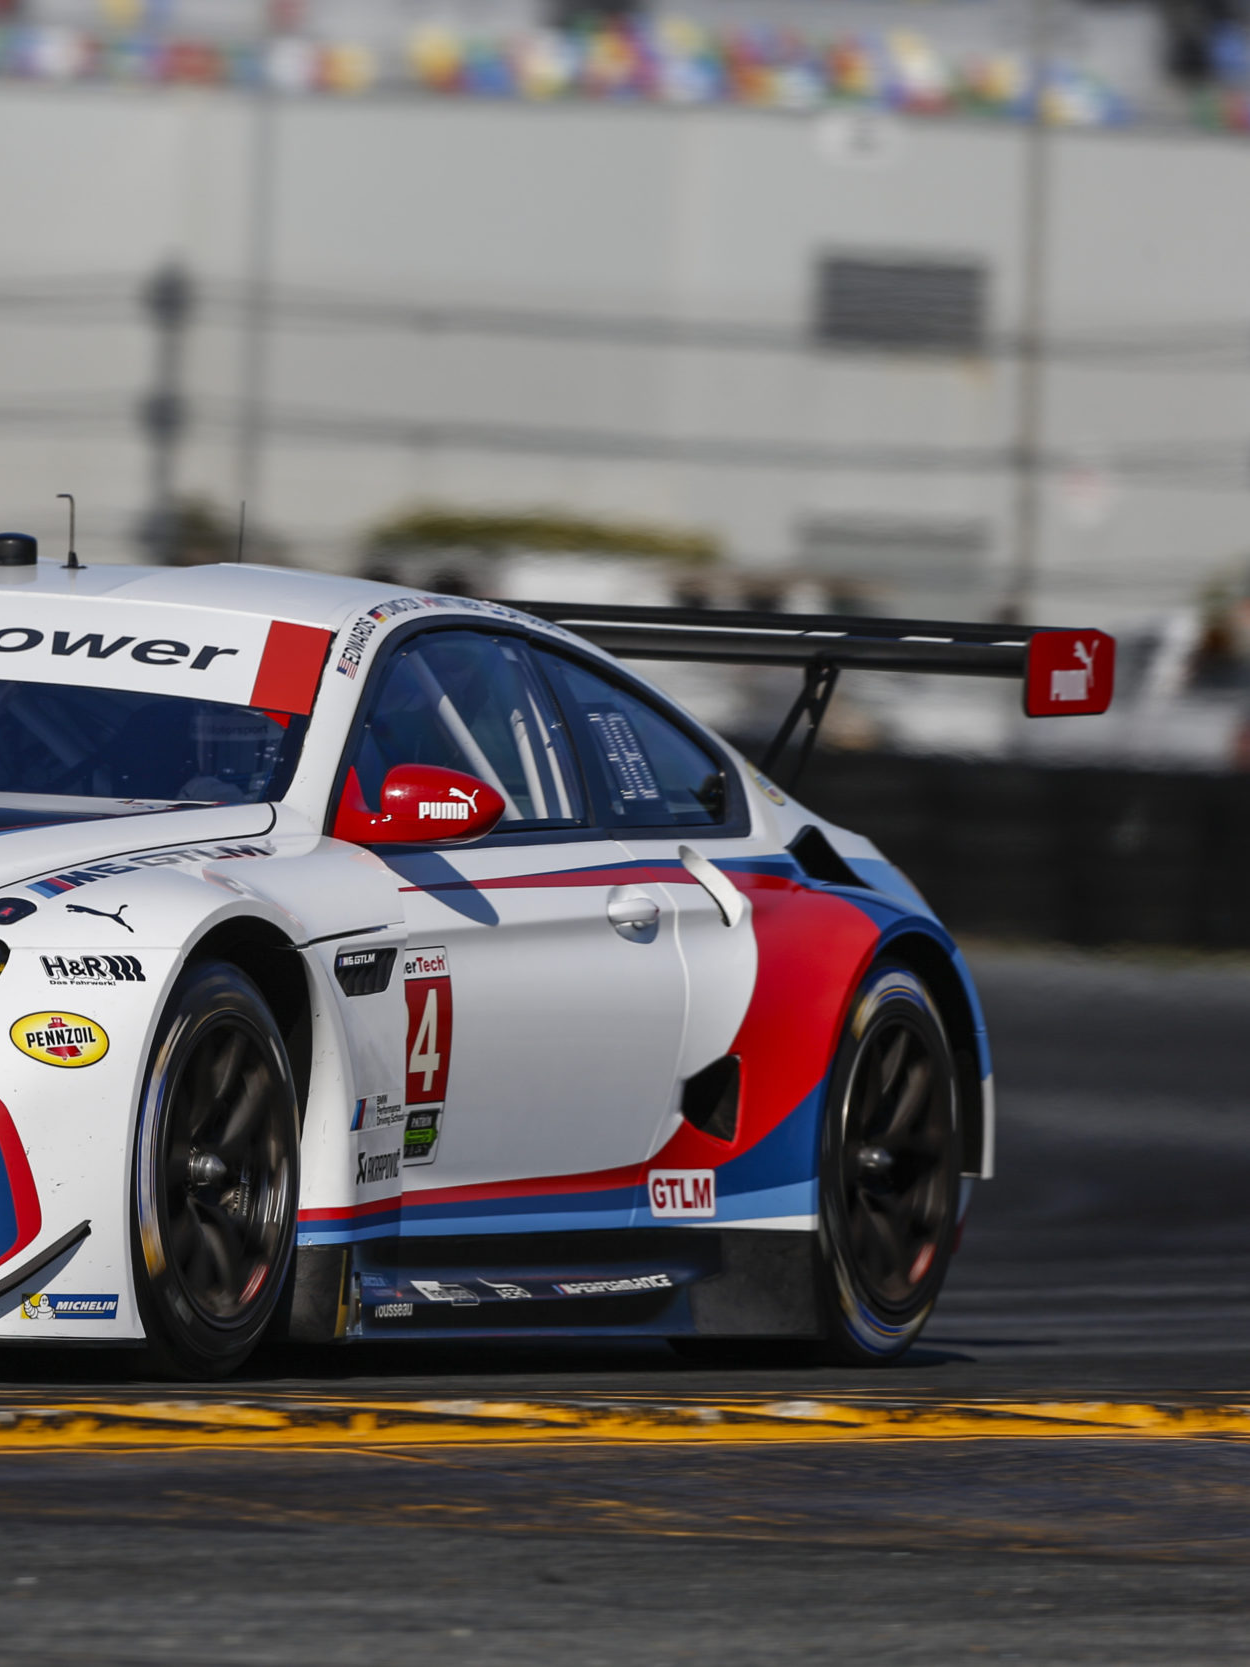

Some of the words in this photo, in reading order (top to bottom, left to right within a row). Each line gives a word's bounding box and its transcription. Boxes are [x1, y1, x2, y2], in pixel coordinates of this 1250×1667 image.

[342, 616, 377, 667] EDWARDS
[419, 802, 468, 819] PUMA
[129, 843, 272, 867] GTLM
[40, 955, 112, 980] H&R
[354, 953, 375, 964] GTLM
[404, 955, 446, 974] erTech
[26, 1026, 97, 1049] PENNZOIL
[405, 988, 441, 1092] 4
[652, 1177, 711, 1209] GTLM
[56, 1301, 117, 1310] MICHELIN
